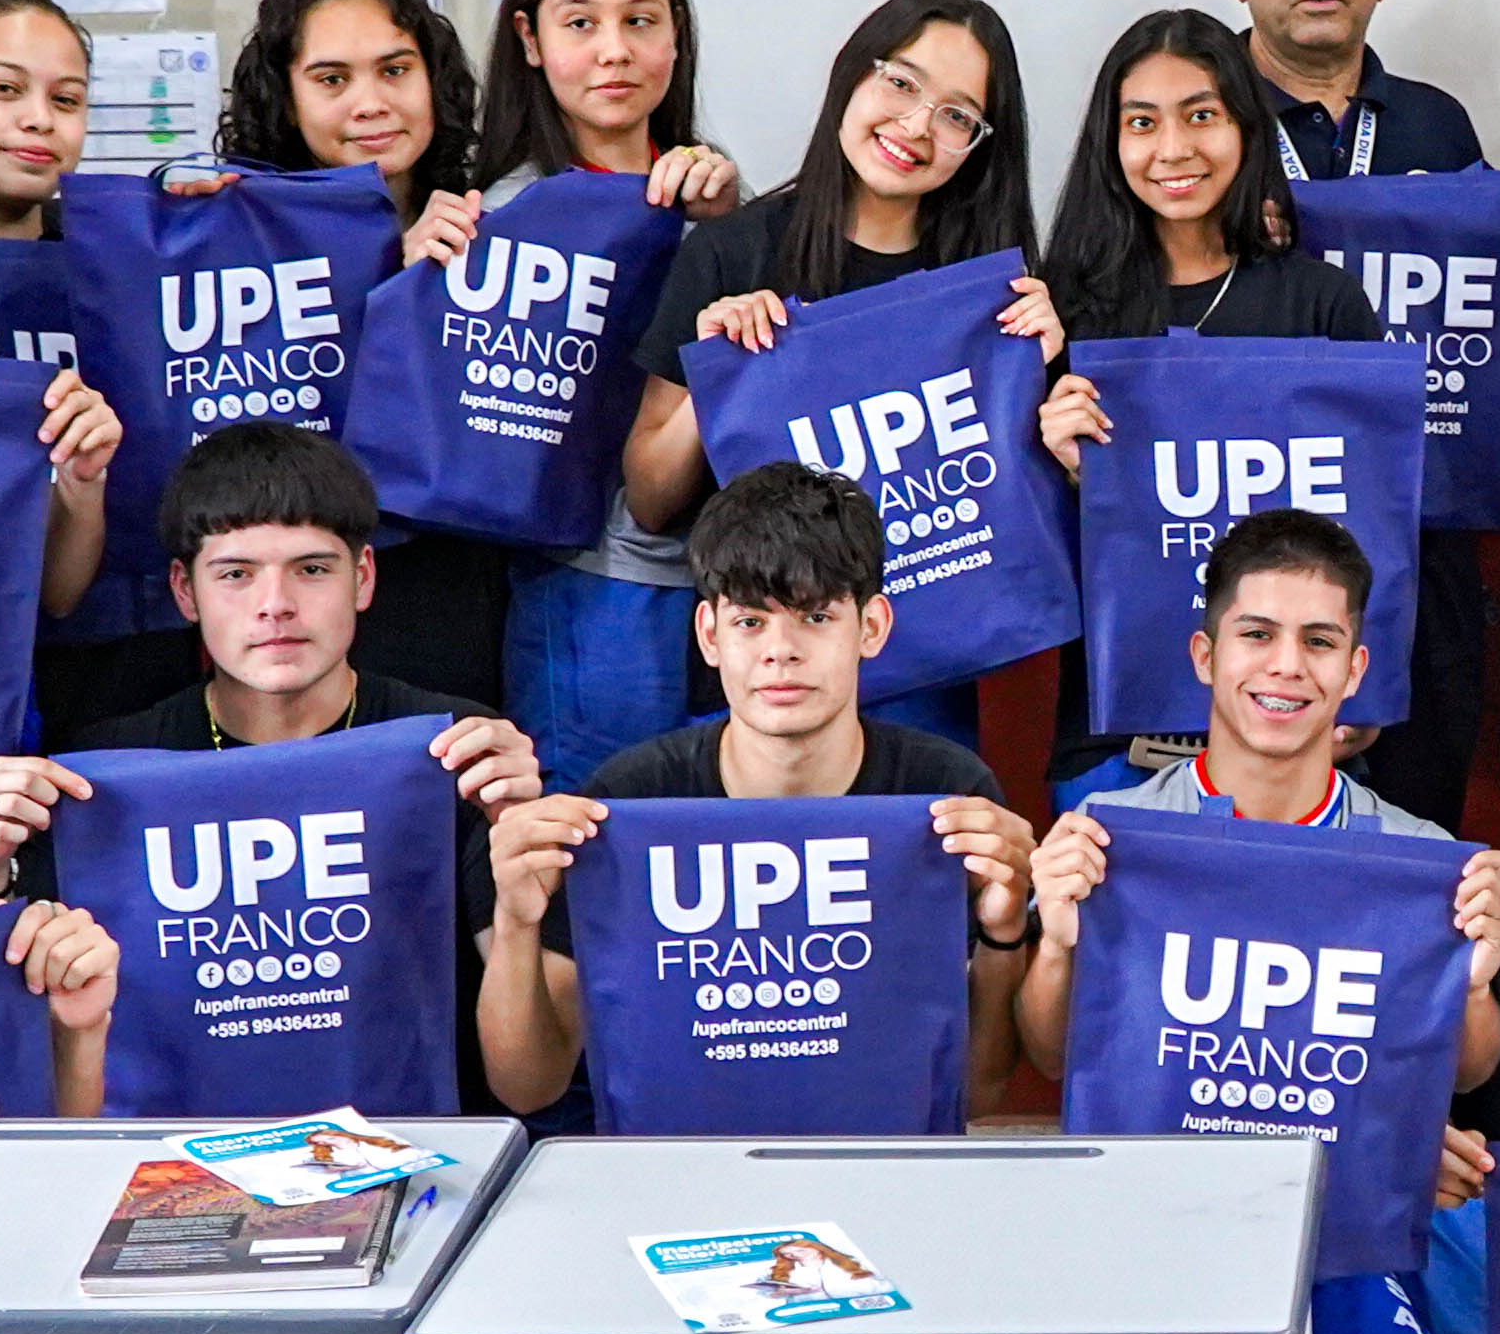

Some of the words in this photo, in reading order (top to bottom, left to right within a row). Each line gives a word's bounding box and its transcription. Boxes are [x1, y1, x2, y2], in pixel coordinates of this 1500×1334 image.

[161, 256, 341, 354] UPE
[442, 236, 617, 334] UPE
[166, 341, 346, 397] FRANCO
[442, 313, 598, 376] FRANCO
[466, 416, 498, 433] +595
[787, 368, 989, 482] UPE
[879, 451, 997, 519] ANCO
[1153, 436, 1347, 517] UPE
[883, 525, 993, 576] pefrancocentral
[916, 550, 993, 585] 994364238
[145, 810, 371, 912] UPE
[649, 837, 873, 933] UPE
[157, 903, 372, 958] FRANCO
[657, 930, 873, 980] FRANCO
[194, 985, 351, 1016] /upefrancocentral
[1160, 931, 1382, 1039] UPE
[207, 1018, 248, 1039] +595
[252, 1011, 343, 1036] 994364238
[692, 1013, 848, 1038] /upefrancocentral
[705, 1042, 746, 1061] +595
[749, 1038, 840, 1059] 994364238
[1157, 1028, 1368, 1085] FRANCO
